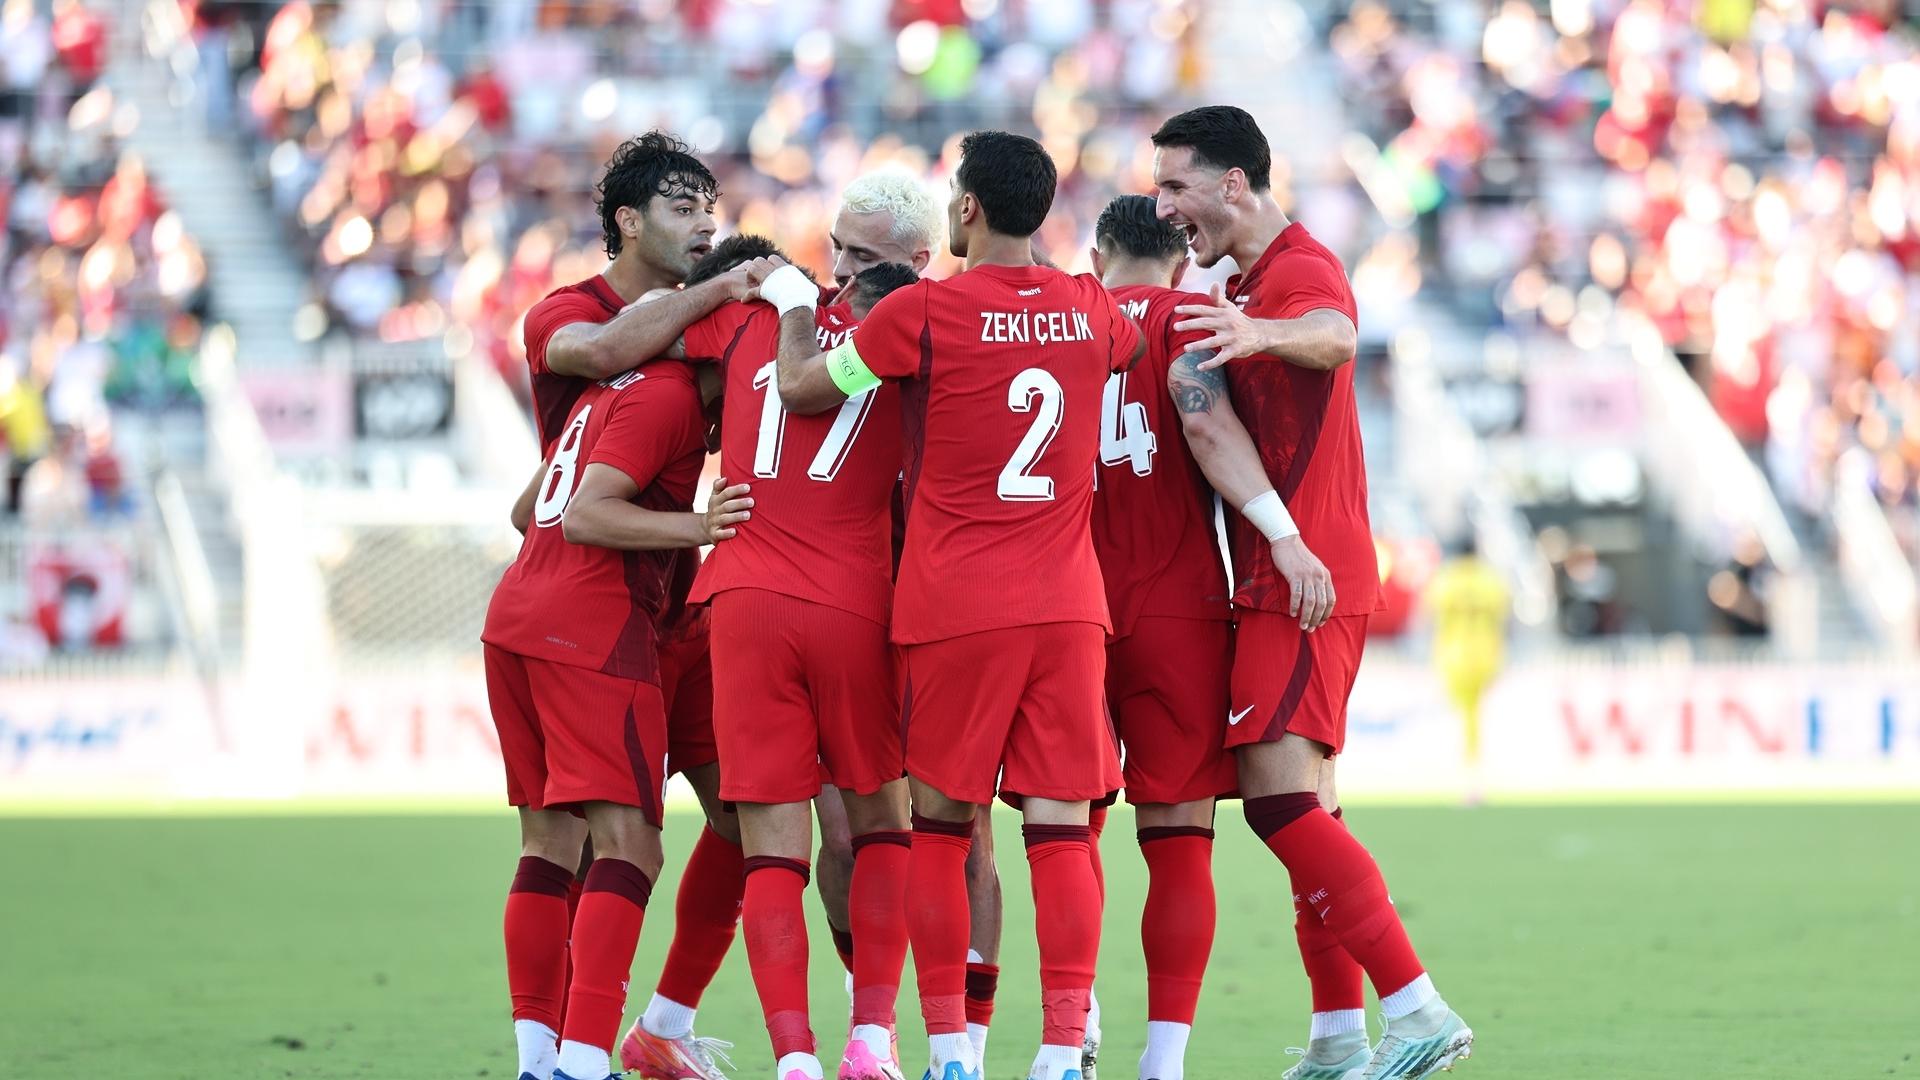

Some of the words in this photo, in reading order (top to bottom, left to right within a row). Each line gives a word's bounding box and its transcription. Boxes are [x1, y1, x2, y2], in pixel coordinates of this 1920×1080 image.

[980, 308, 1030, 343] ZEKİ
[1033, 306, 1095, 346] ÇELİK
[534, 404, 593, 528] 8
[753, 360, 878, 482] 17
[997, 367, 1065, 502] 2
